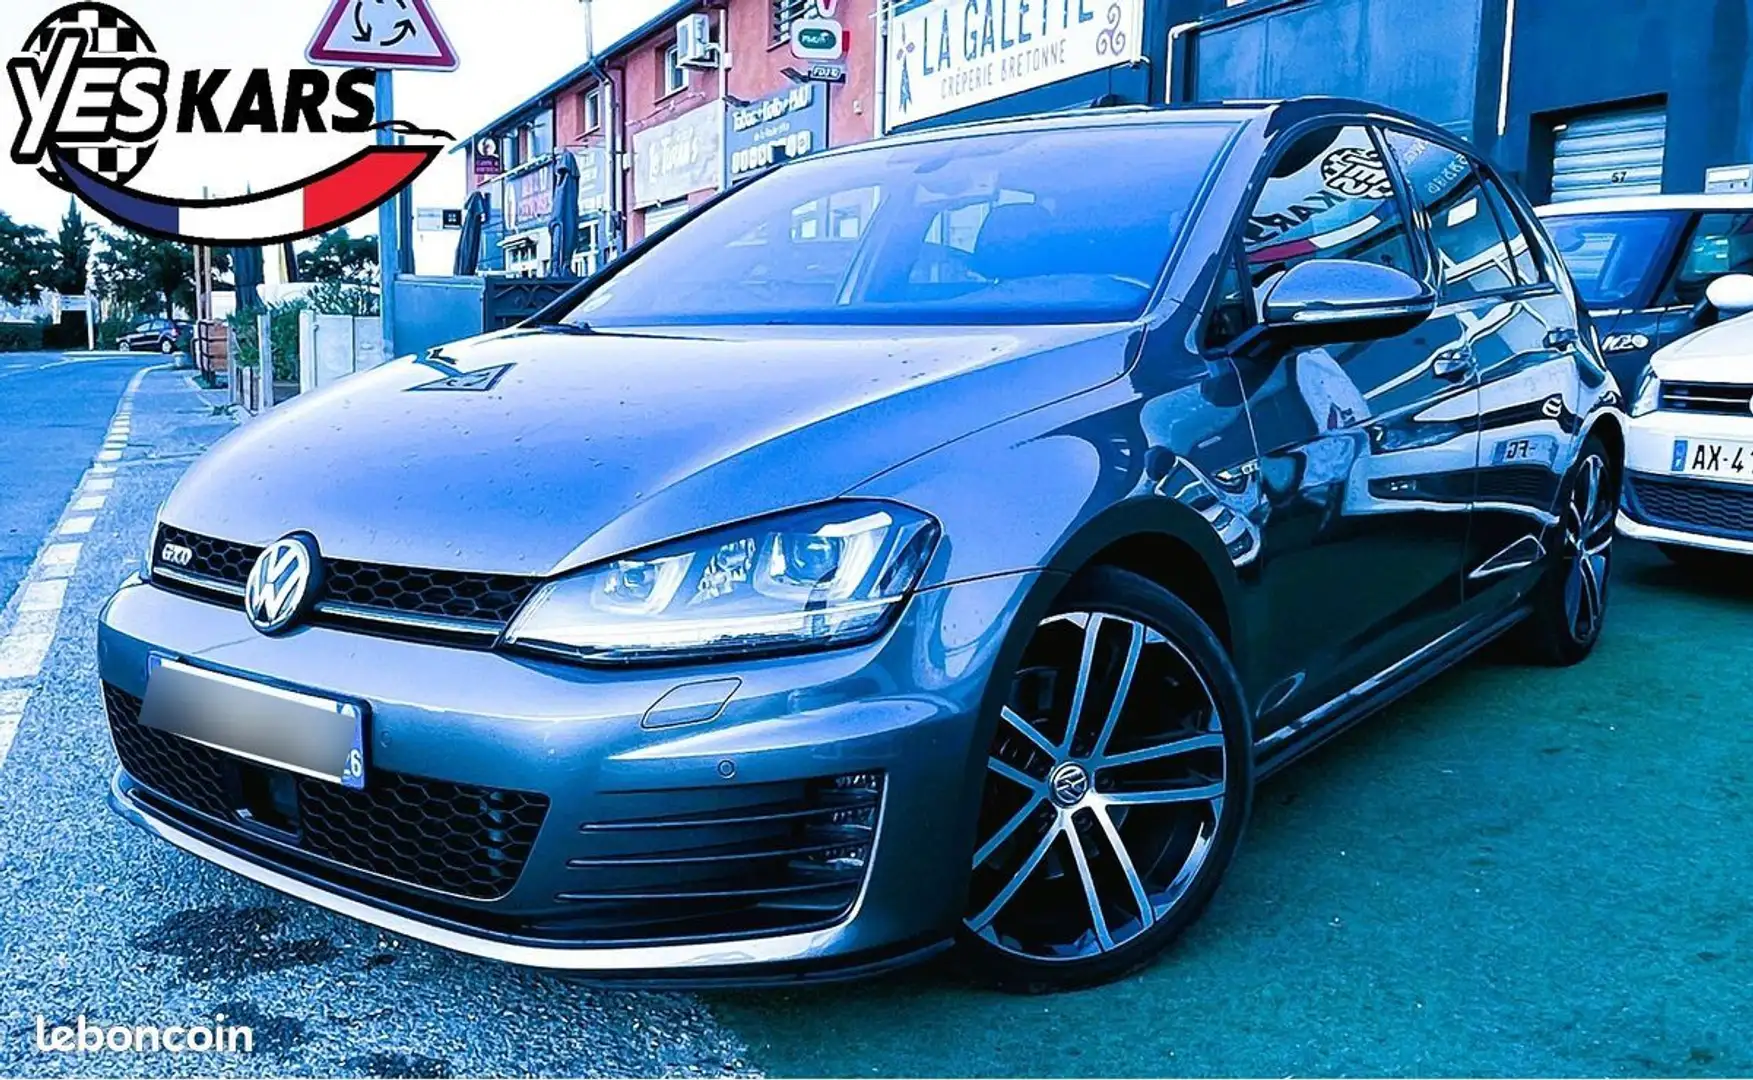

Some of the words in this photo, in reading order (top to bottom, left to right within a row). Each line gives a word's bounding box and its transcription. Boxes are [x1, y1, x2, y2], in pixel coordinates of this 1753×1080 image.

[922, 8, 951, 76] LA
[940, 63, 994, 99] CRÉPERIE
[1000, 39, 1067, 82] BRETONNE
[1611, 171, 1628, 184] 57
